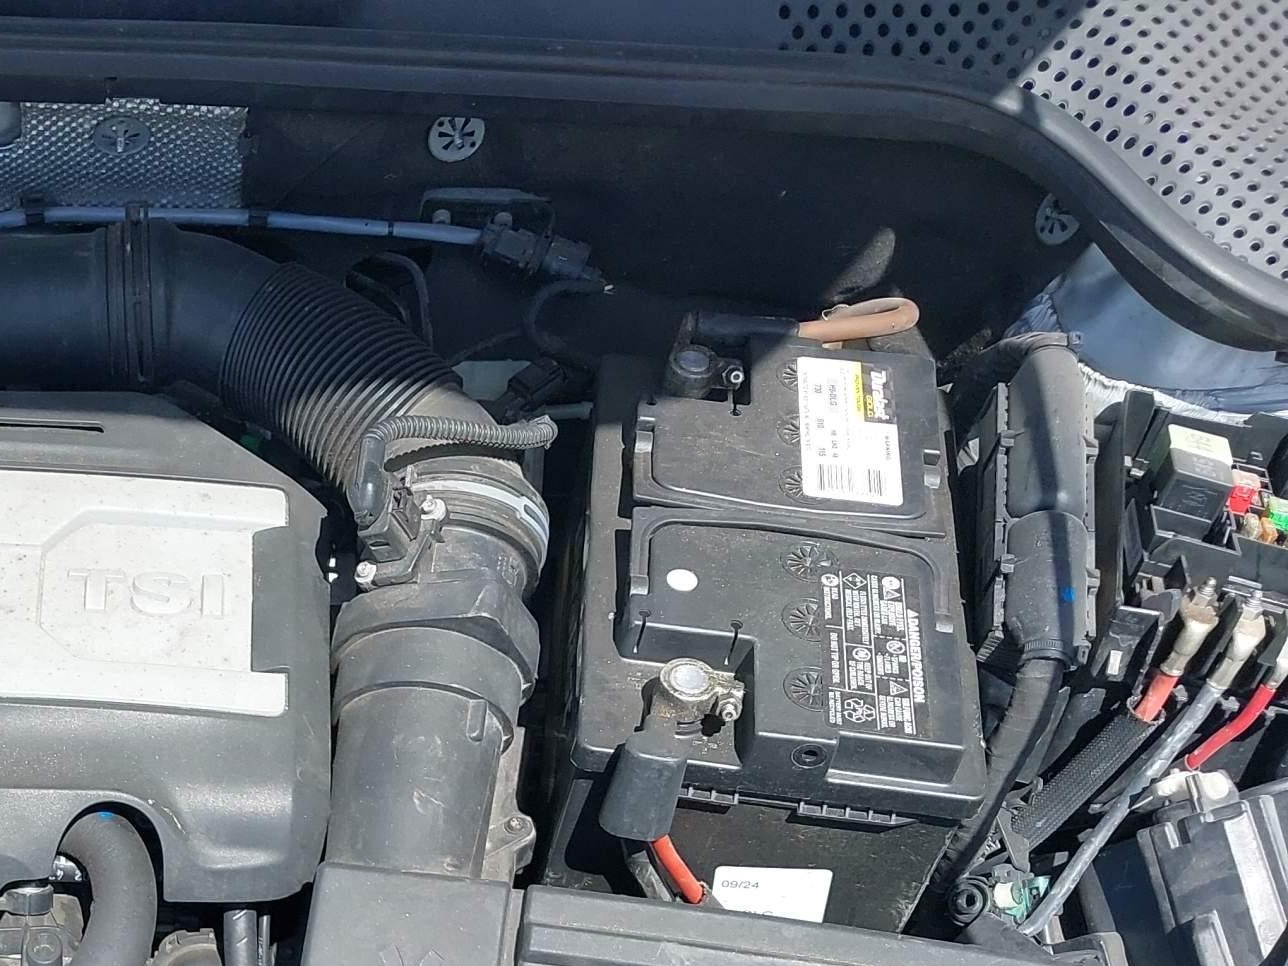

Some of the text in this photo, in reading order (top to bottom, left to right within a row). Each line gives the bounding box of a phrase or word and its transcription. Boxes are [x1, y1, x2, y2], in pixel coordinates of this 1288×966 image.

[866, 395, 874, 418] GOLD
[870, 369, 890, 421] Duralast
[67, 567, 225, 619] TSI
[908, 618, 925, 703] DANGER/POISON
[721, 880, 760, 889] 09/24
